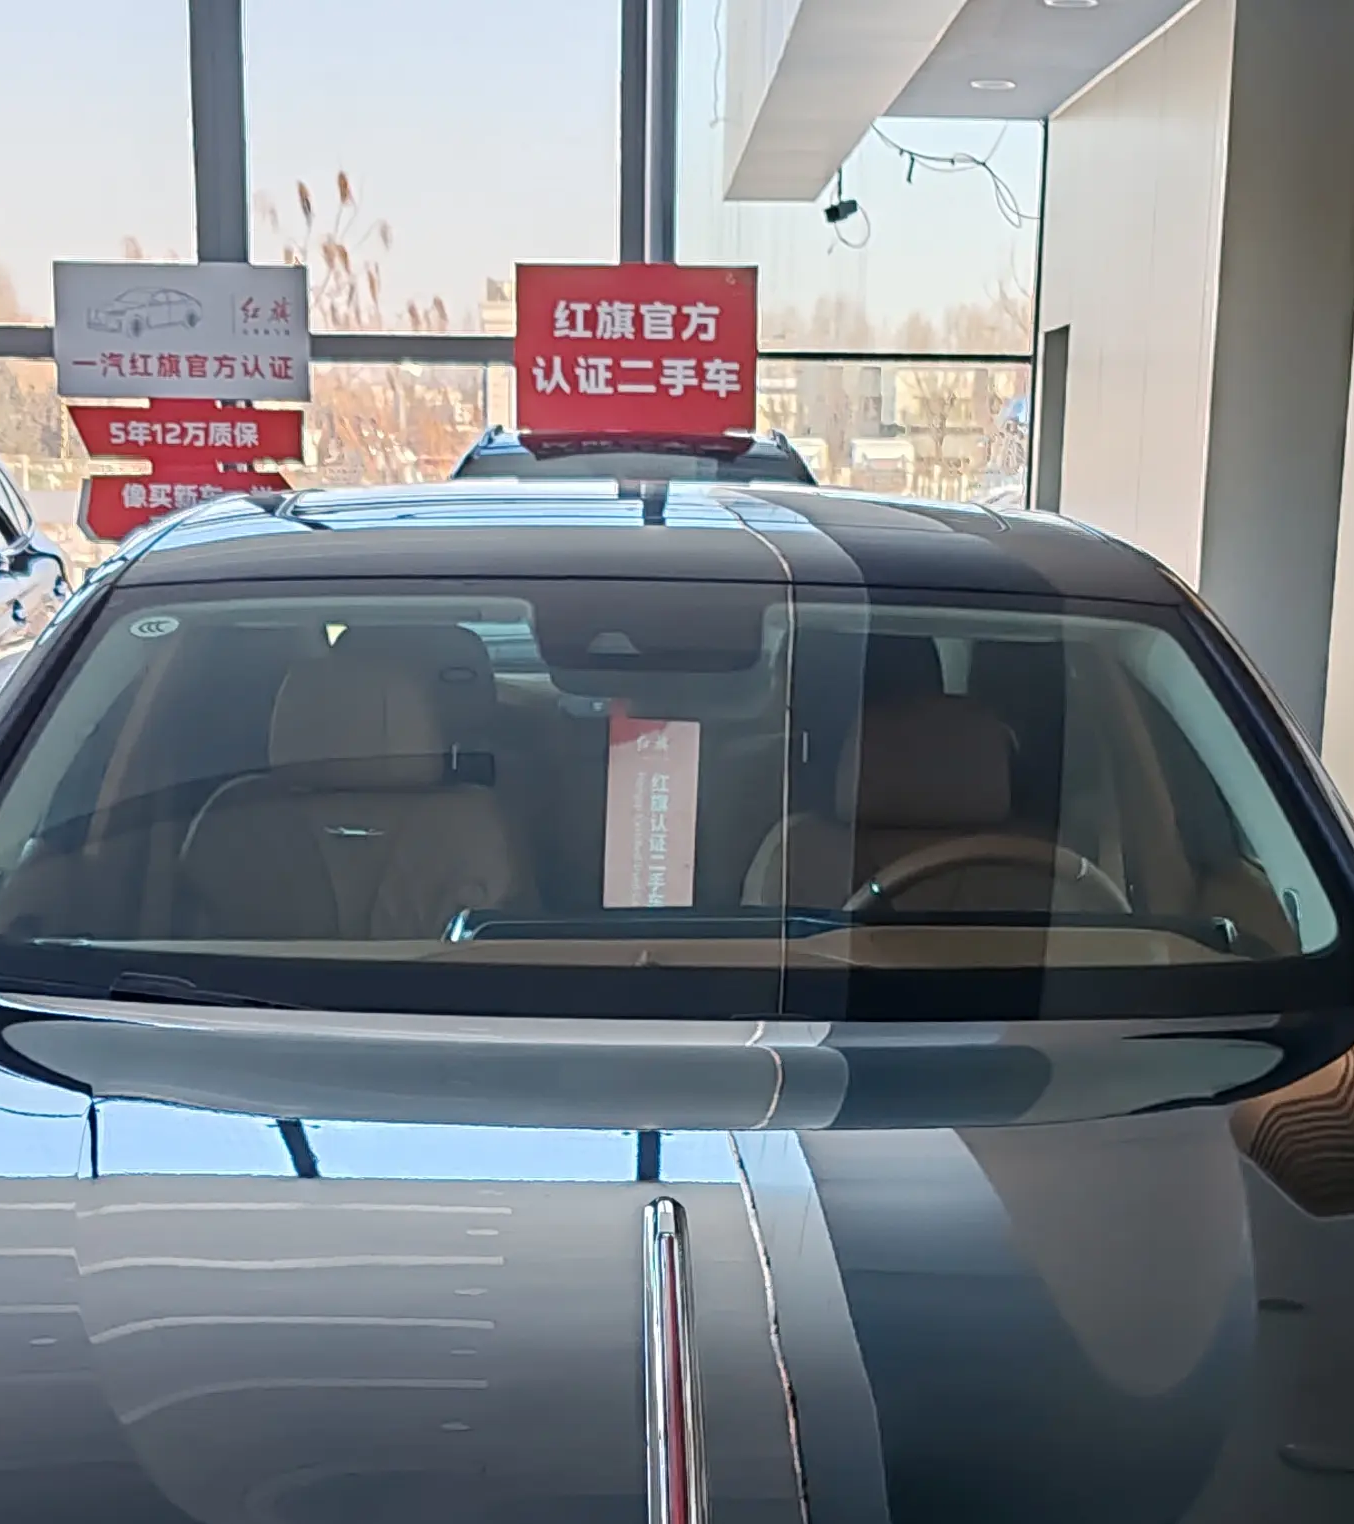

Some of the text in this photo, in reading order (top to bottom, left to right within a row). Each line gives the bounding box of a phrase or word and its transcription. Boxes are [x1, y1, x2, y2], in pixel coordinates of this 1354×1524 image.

[552, 299, 721, 342] 红旗官方
[71, 351, 295, 381] 一汽红旗官方认证
[531, 355, 742, 399] 认证二手车
[108, 420, 260, 448] 5年12万质保
